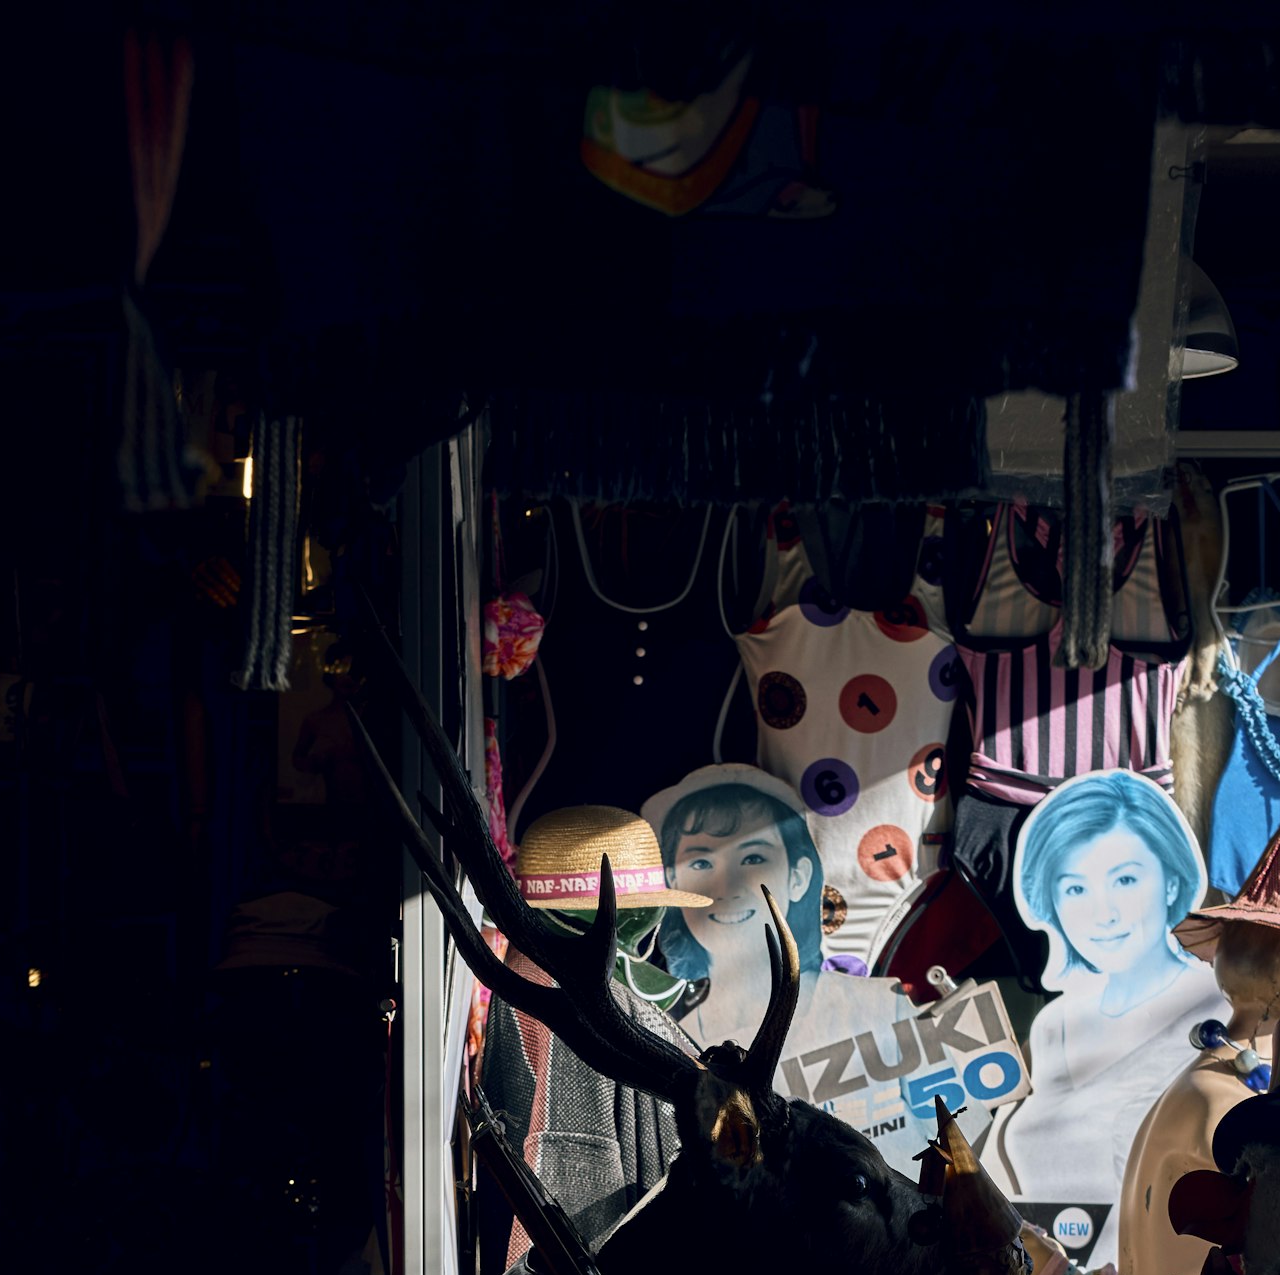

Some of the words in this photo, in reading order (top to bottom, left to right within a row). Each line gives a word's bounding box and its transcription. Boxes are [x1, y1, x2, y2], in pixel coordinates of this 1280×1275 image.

[526, 876, 598, 894] NAF-NAF
[908, 1051, 1021, 1120] 50
[1058, 1222, 1090, 1237] NEW
